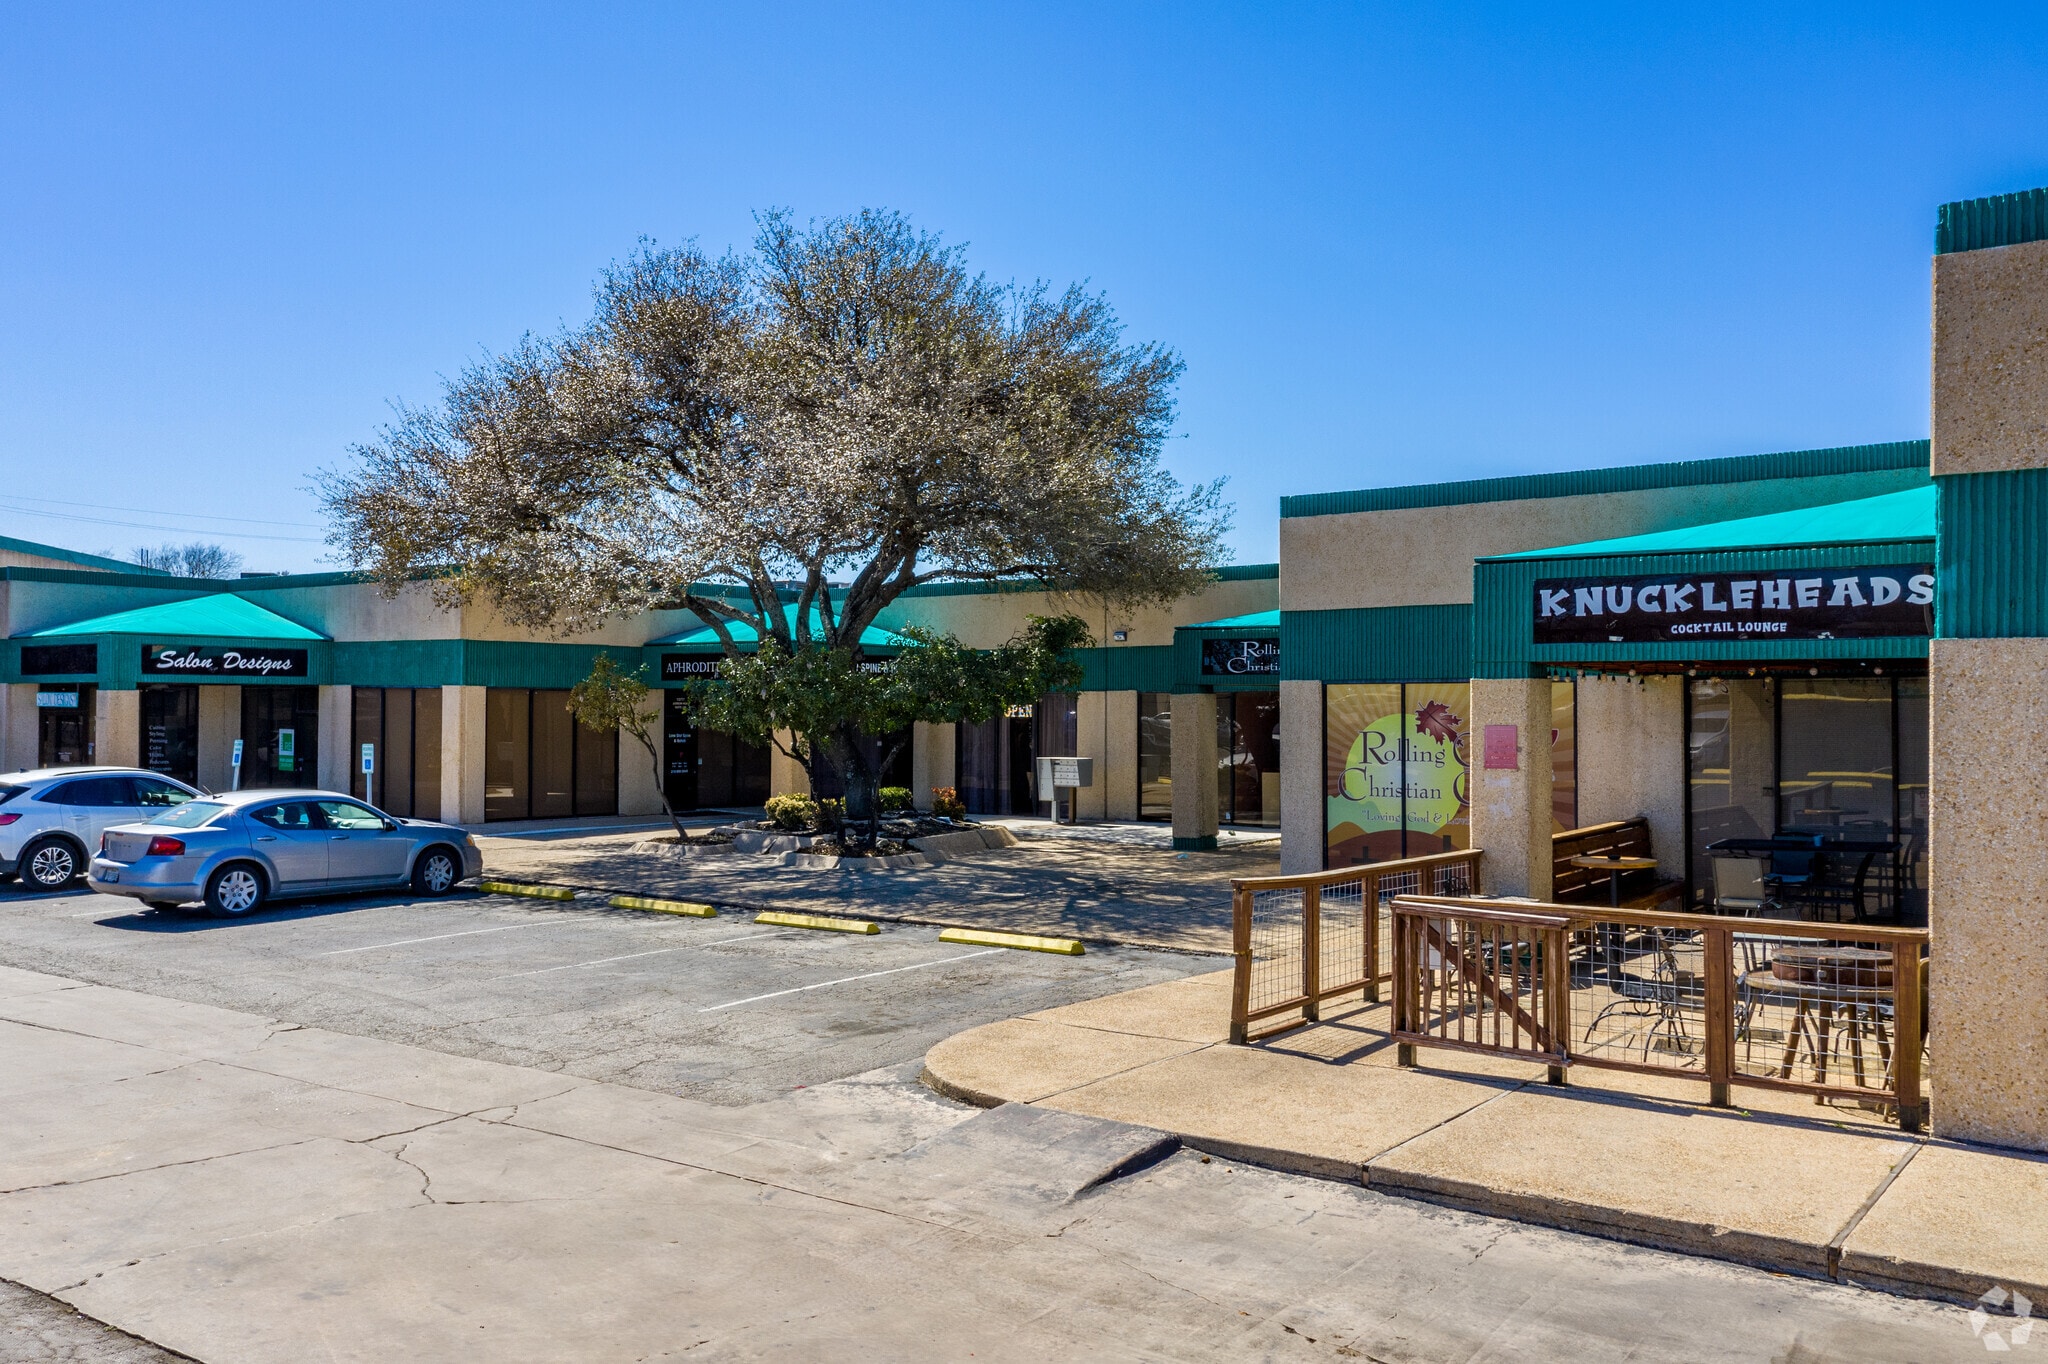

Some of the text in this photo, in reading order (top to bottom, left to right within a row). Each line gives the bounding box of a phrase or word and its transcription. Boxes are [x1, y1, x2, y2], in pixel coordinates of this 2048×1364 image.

[1539, 574, 1935, 617] KNUCKLEHEADS
[1671, 622, 1788, 634] COCKTAIL LOUNGE
[156, 650, 293, 675] Salon Designs
[1227, 657, 1280, 674] Christi
[1003, 704, 1033, 718] OPEN
[1358, 730, 1446, 769] Rolling
[1337, 765, 1443, 802] Christian
[1407, 811, 1430, 824] God
[1433, 812, 1443, 824] &
